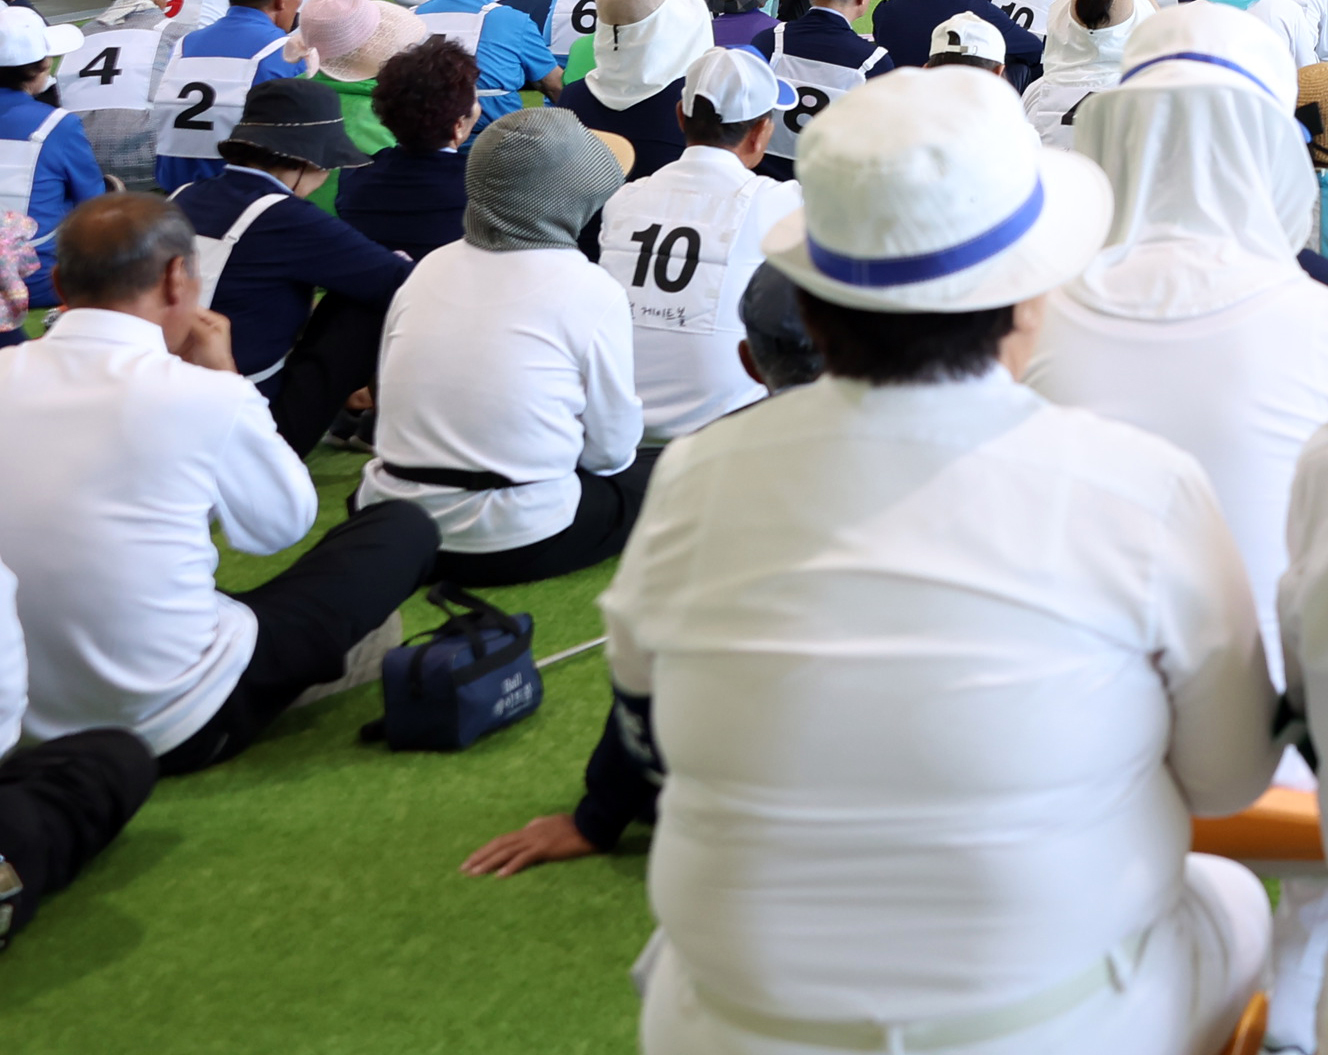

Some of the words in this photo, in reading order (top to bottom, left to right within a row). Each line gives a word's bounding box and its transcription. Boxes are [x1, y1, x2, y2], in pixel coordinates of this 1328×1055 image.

[78, 46, 123, 85] 4
[173, 81, 217, 131] 2
[782, 86, 831, 134] 8
[630, 222, 702, 294] 10
